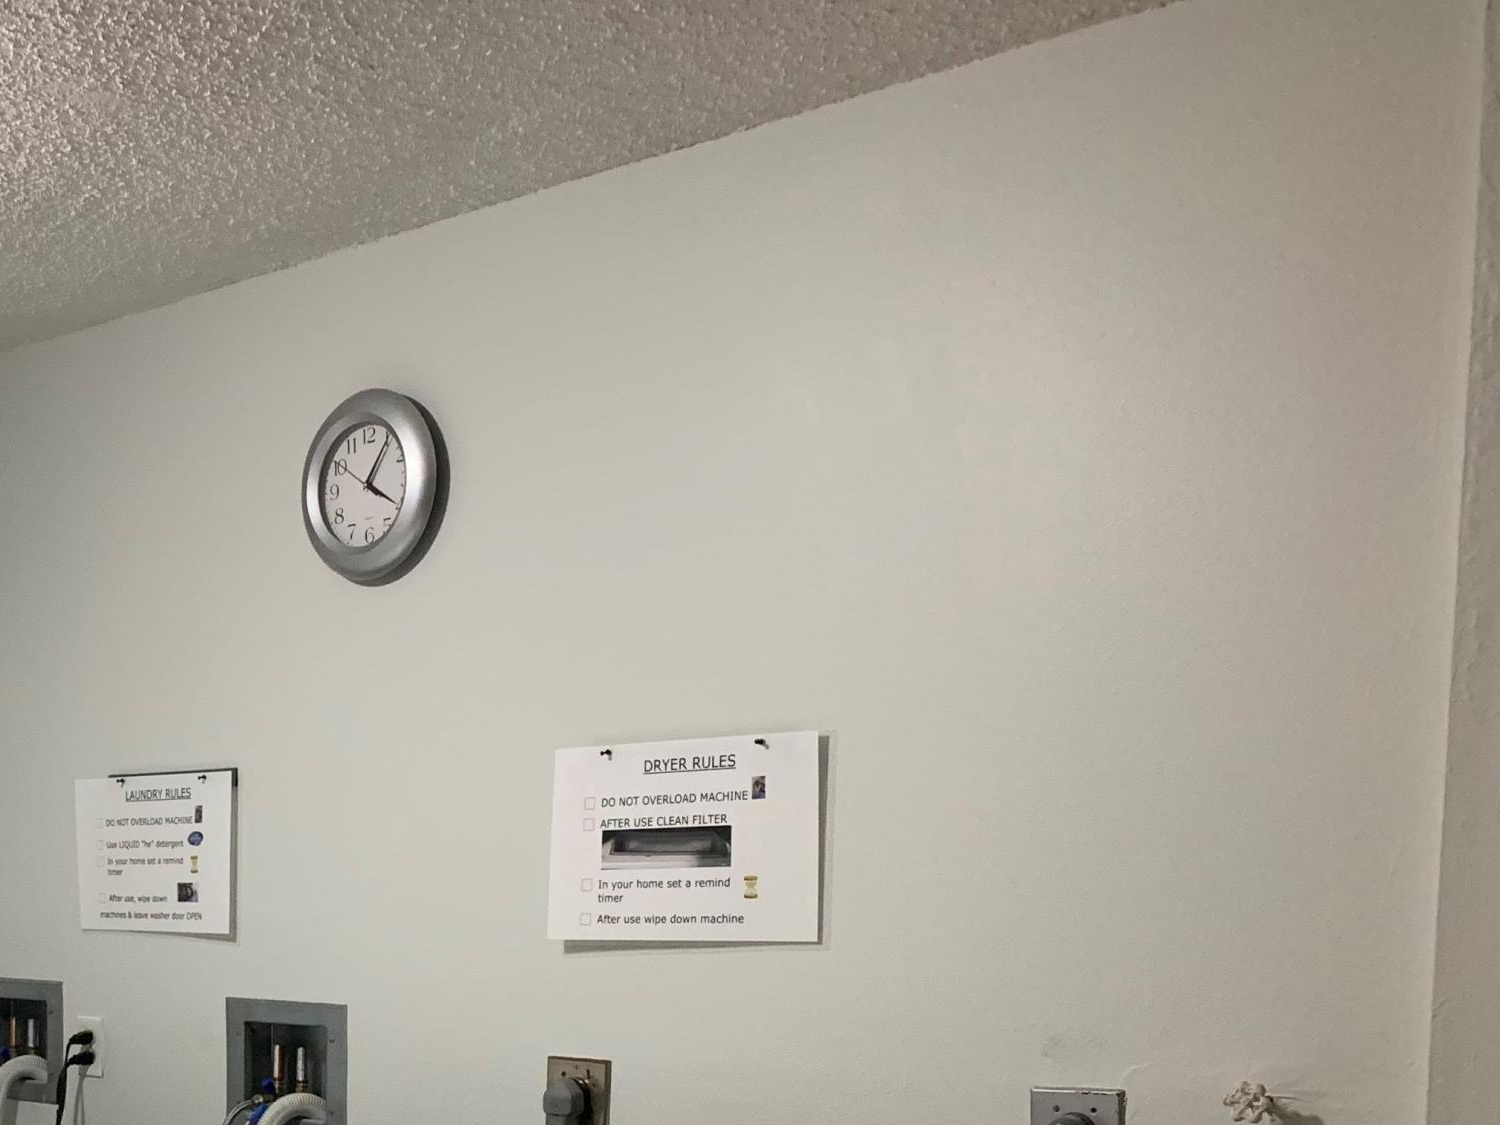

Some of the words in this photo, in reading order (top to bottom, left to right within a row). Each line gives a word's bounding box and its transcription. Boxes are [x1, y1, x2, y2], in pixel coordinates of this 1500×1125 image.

[363, 426, 376, 445] 12
[347, 437, 357, 454] 11
[334, 458, 347, 476] 10
[330, 484, 340, 500] 9
[334, 507, 345, 525] 8
[348, 523, 356, 540] 7
[364, 526, 375, 544] 6
[644, 758, 687, 772] DRYER
[693, 755, 736, 769] RULES
[125, 789, 162, 800] LAUNDRY
[166, 788, 191, 799] RULES
[619, 796, 639, 806] NOT
[642, 794, 696, 805] OVERLOAD
[701, 791, 748, 800] MACHINE
[131, 817, 162, 825] OVERLOAD
[601, 818, 630, 828] AFTER
[634, 817, 653, 827] USE
[657, 815, 688, 825] CLEAN
[693, 814, 727, 824] FILTER
[119, 841, 140, 849] LIQUID
[156, 841, 183, 849] detergent
[115, 858, 127, 866] your
[612, 881, 633, 891] your
[636, 879, 663, 888] home
[667, 879, 681, 888] set
[695, 878, 730, 888] remind
[109, 894, 123, 902] After
[598, 894, 623, 903] timer
[172, 912, 184, 920] door
[597, 914, 620, 924] After
[624, 916, 640, 924] use
[644, 914, 666, 925] wipe
[670, 914, 696, 923] down
[701, 914, 744, 923] machine
